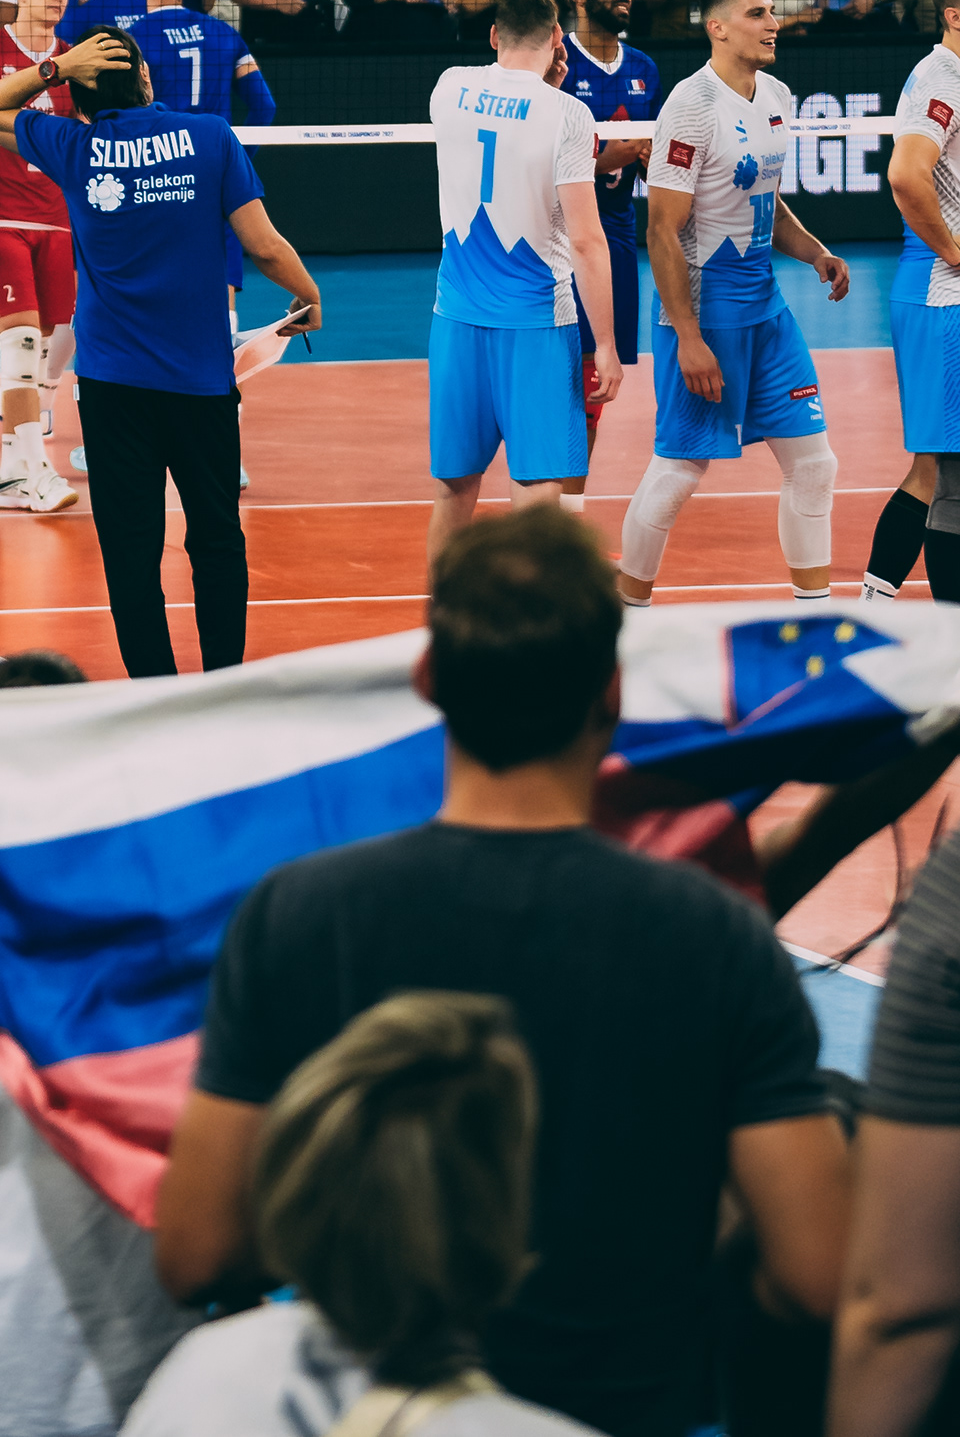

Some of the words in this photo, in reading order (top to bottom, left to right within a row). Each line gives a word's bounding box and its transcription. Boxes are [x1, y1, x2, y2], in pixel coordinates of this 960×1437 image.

[179, 47, 200, 106] 7
[90, 129, 195, 168] SLOVENIA
[477, 128, 497, 203] 1
[134, 174, 195, 190] Telekom
[134, 187, 195, 204] Slovenije
[3, 285, 16, 302] 2
